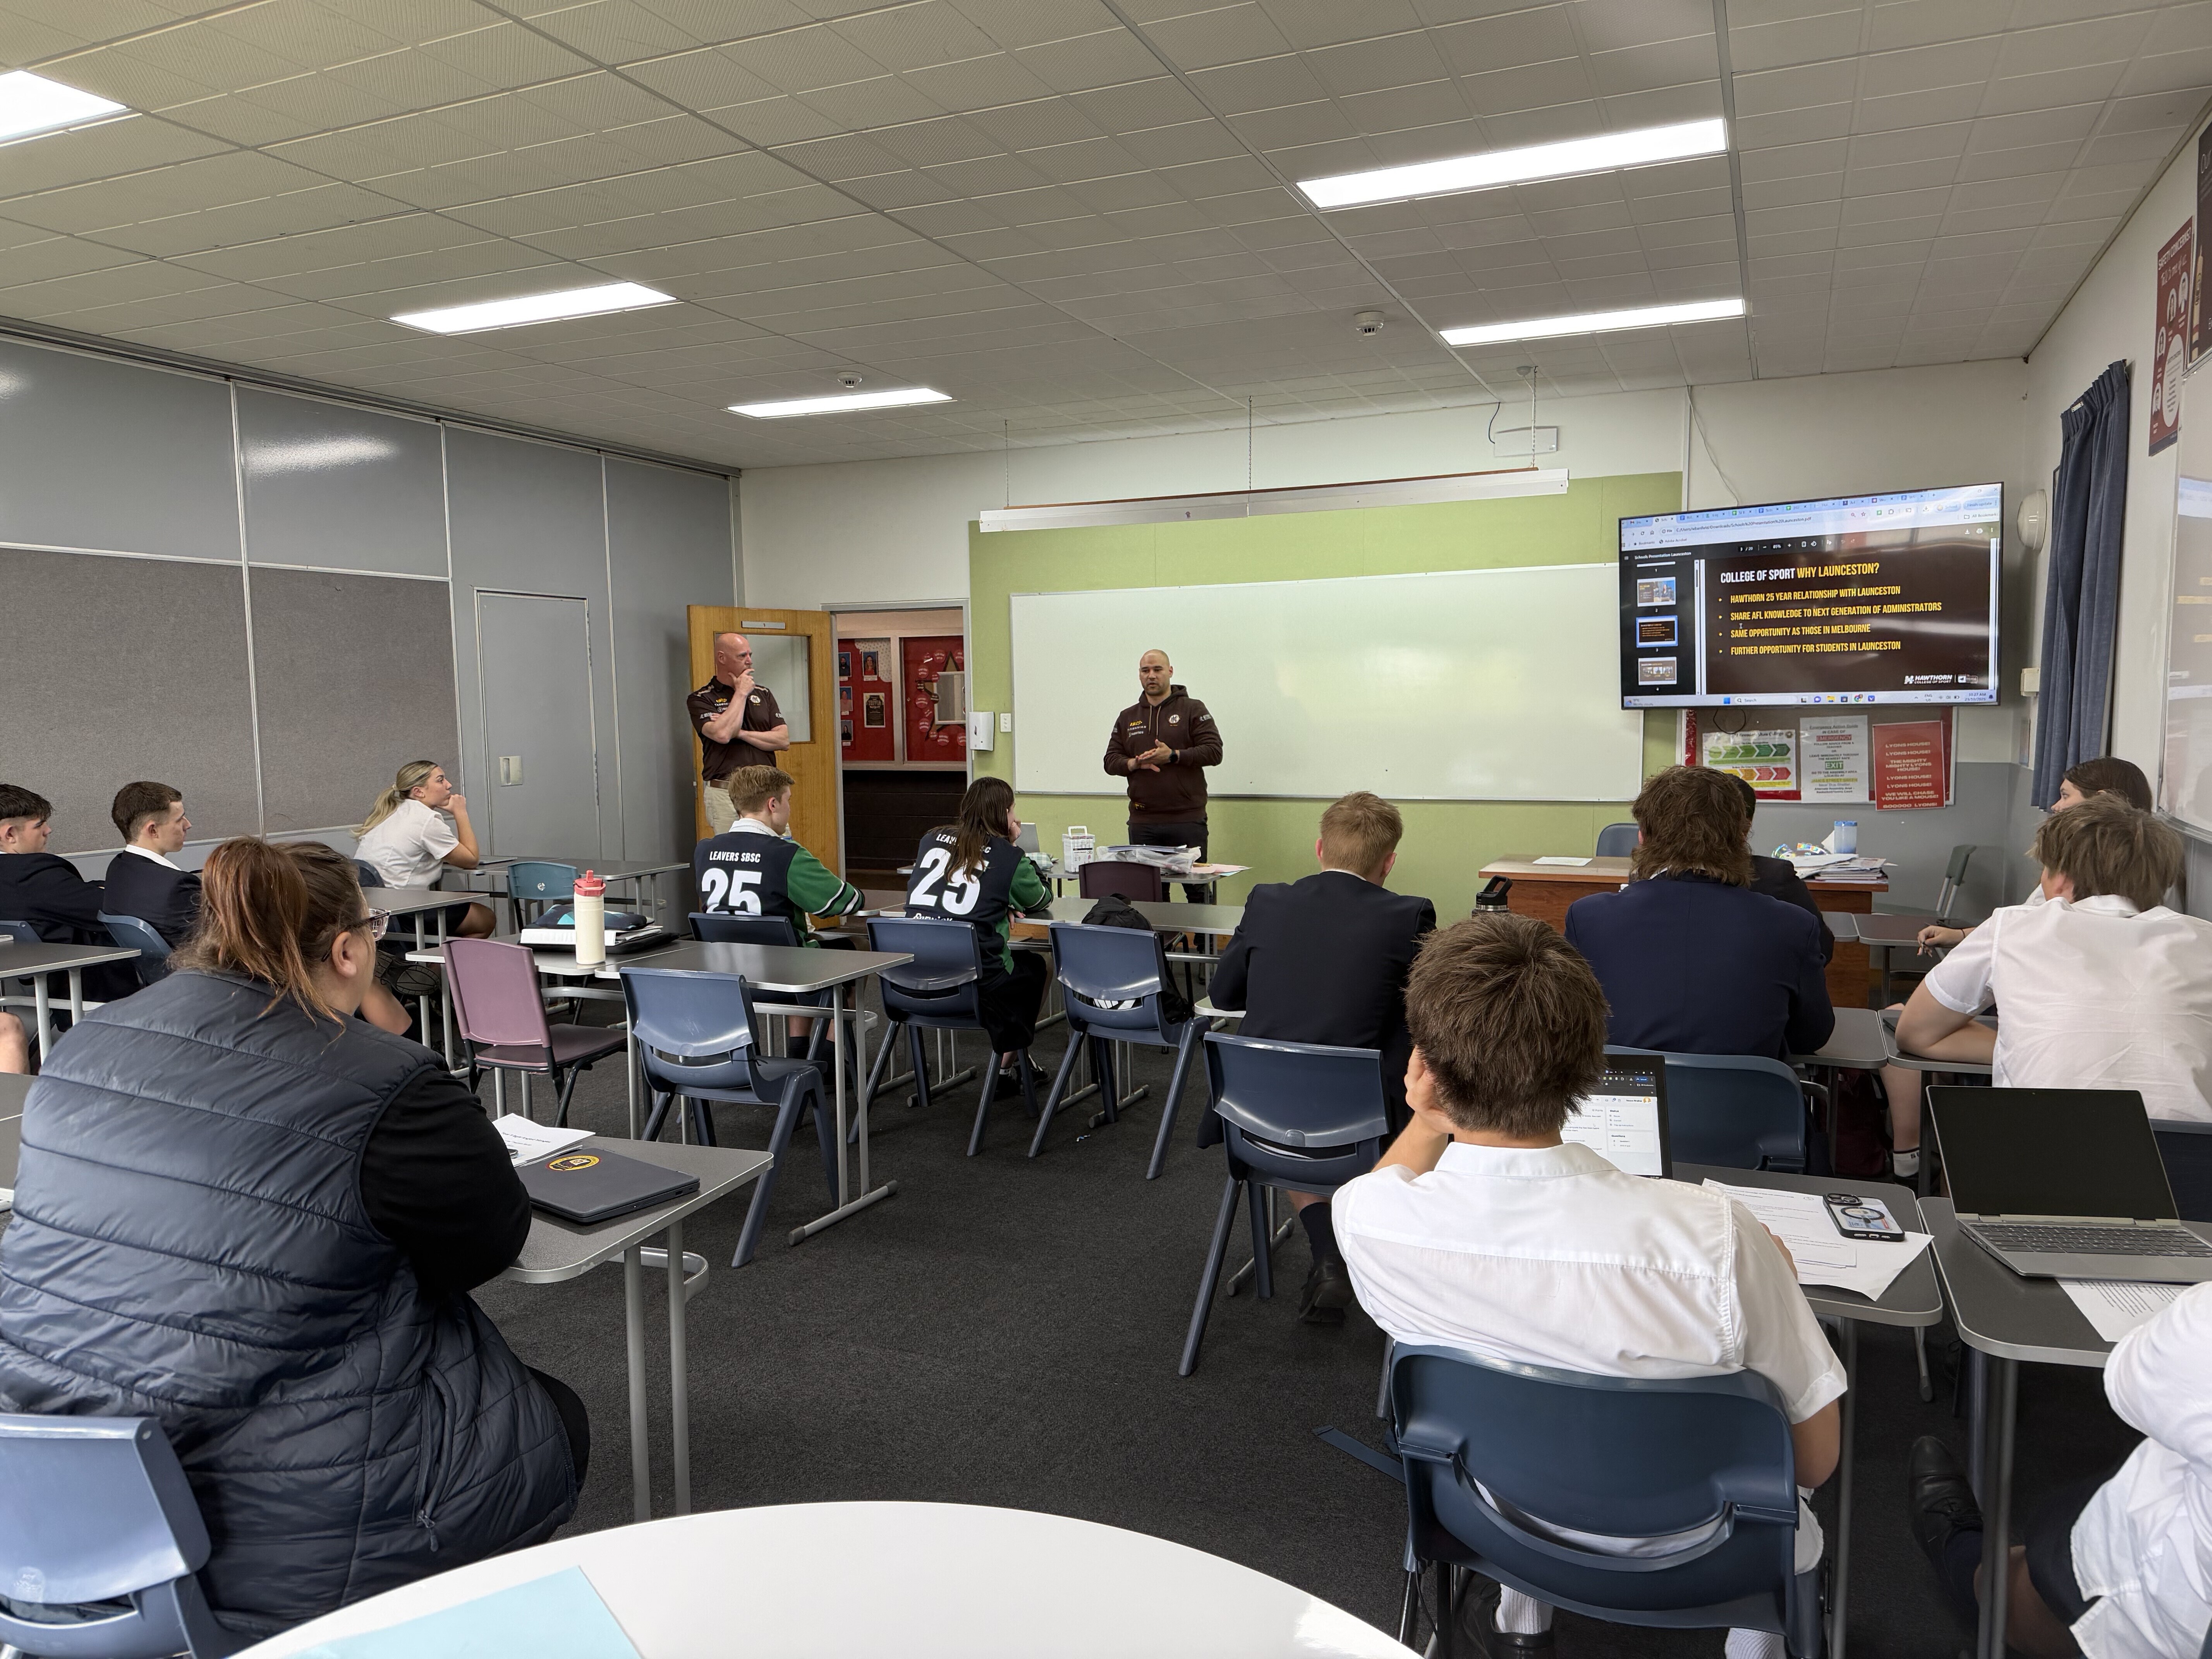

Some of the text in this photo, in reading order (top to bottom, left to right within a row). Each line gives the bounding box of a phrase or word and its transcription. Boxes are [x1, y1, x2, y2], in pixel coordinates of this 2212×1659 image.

[1721, 562, 1879, 583] COLLEGE OF SPORT WHY LAUNCESTON?
[1731, 586, 1901, 603] HAWTHORN 25 YEAR RELATIONSHIP WITH LAUNCESTON
[1730, 602, 1942, 621] SHARE AFL KNOWLEDGE TO NEXT GENERATION OF ADMINISTRATORS
[1730, 624, 1871, 638] SAME OPPORTUNITY AS THOSE IN MELBOURNE
[1731, 641, 1901, 655] FURTHER OPPORTUNITY FOR STUDENTS IN LAUNCESTON
[709, 851, 761, 863] LEAVERS SBSC
[909, 847, 989, 915] 25
[702, 868, 762, 916] 25
